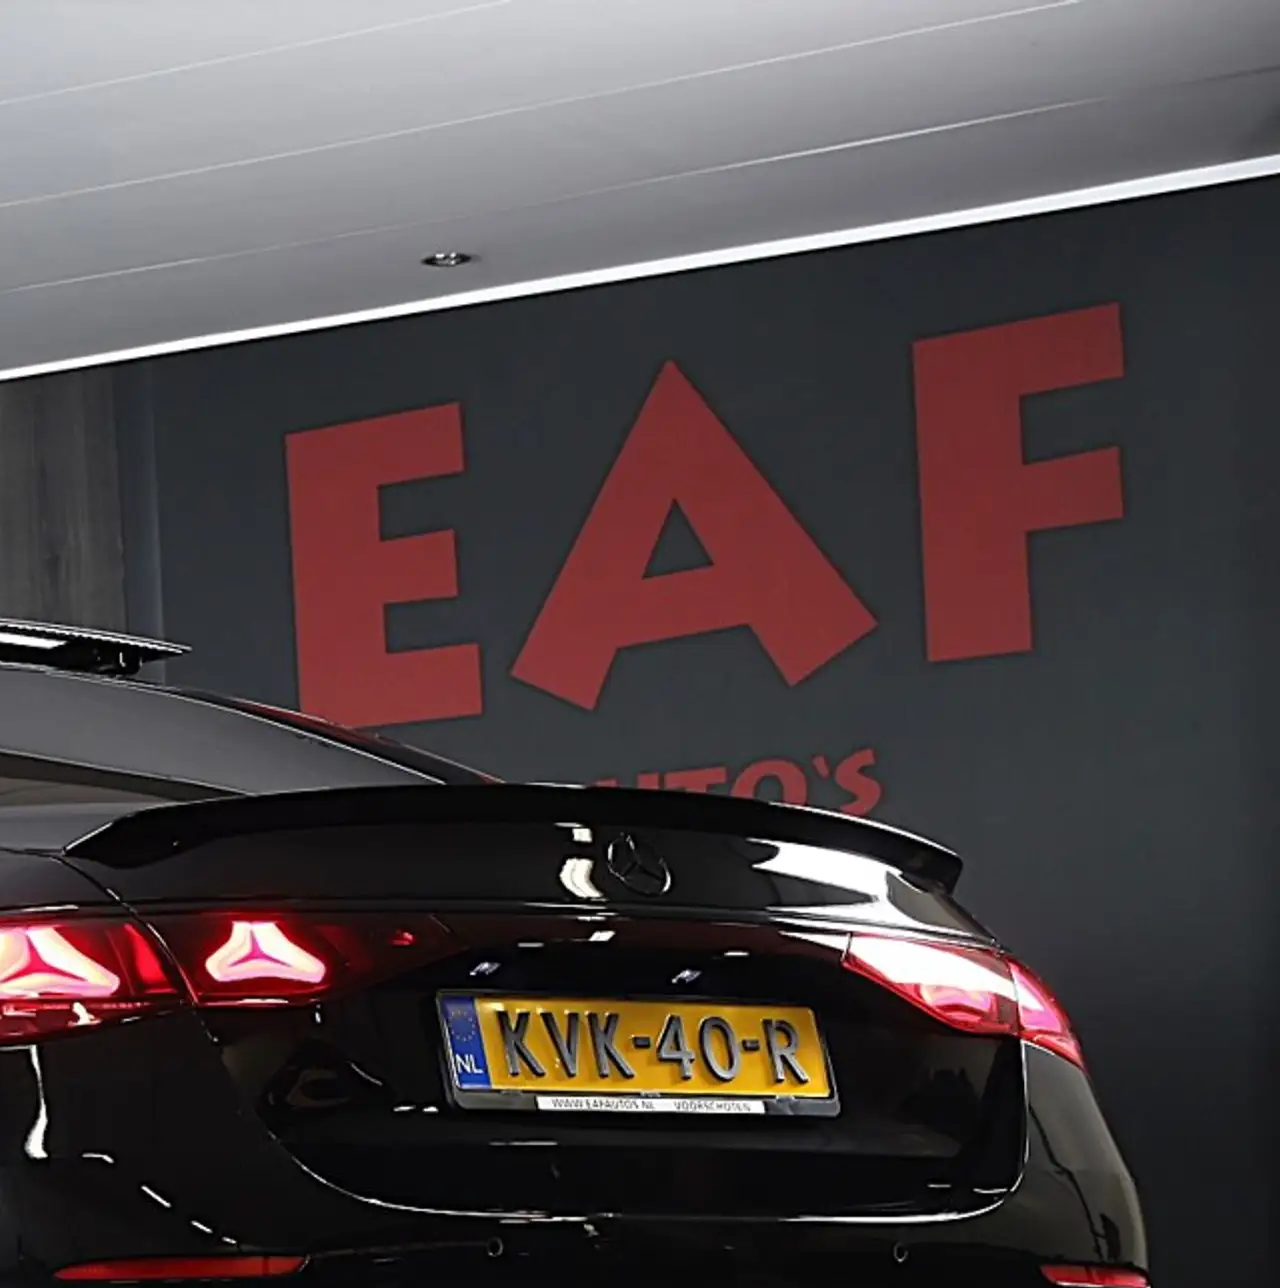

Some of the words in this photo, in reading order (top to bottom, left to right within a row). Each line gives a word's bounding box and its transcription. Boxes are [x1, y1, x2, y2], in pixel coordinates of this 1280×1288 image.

[284, 302, 1125, 729] EAF
[456, 1055, 483, 1075] NL
[496, 1008, 809, 1085] KVK-40-R
